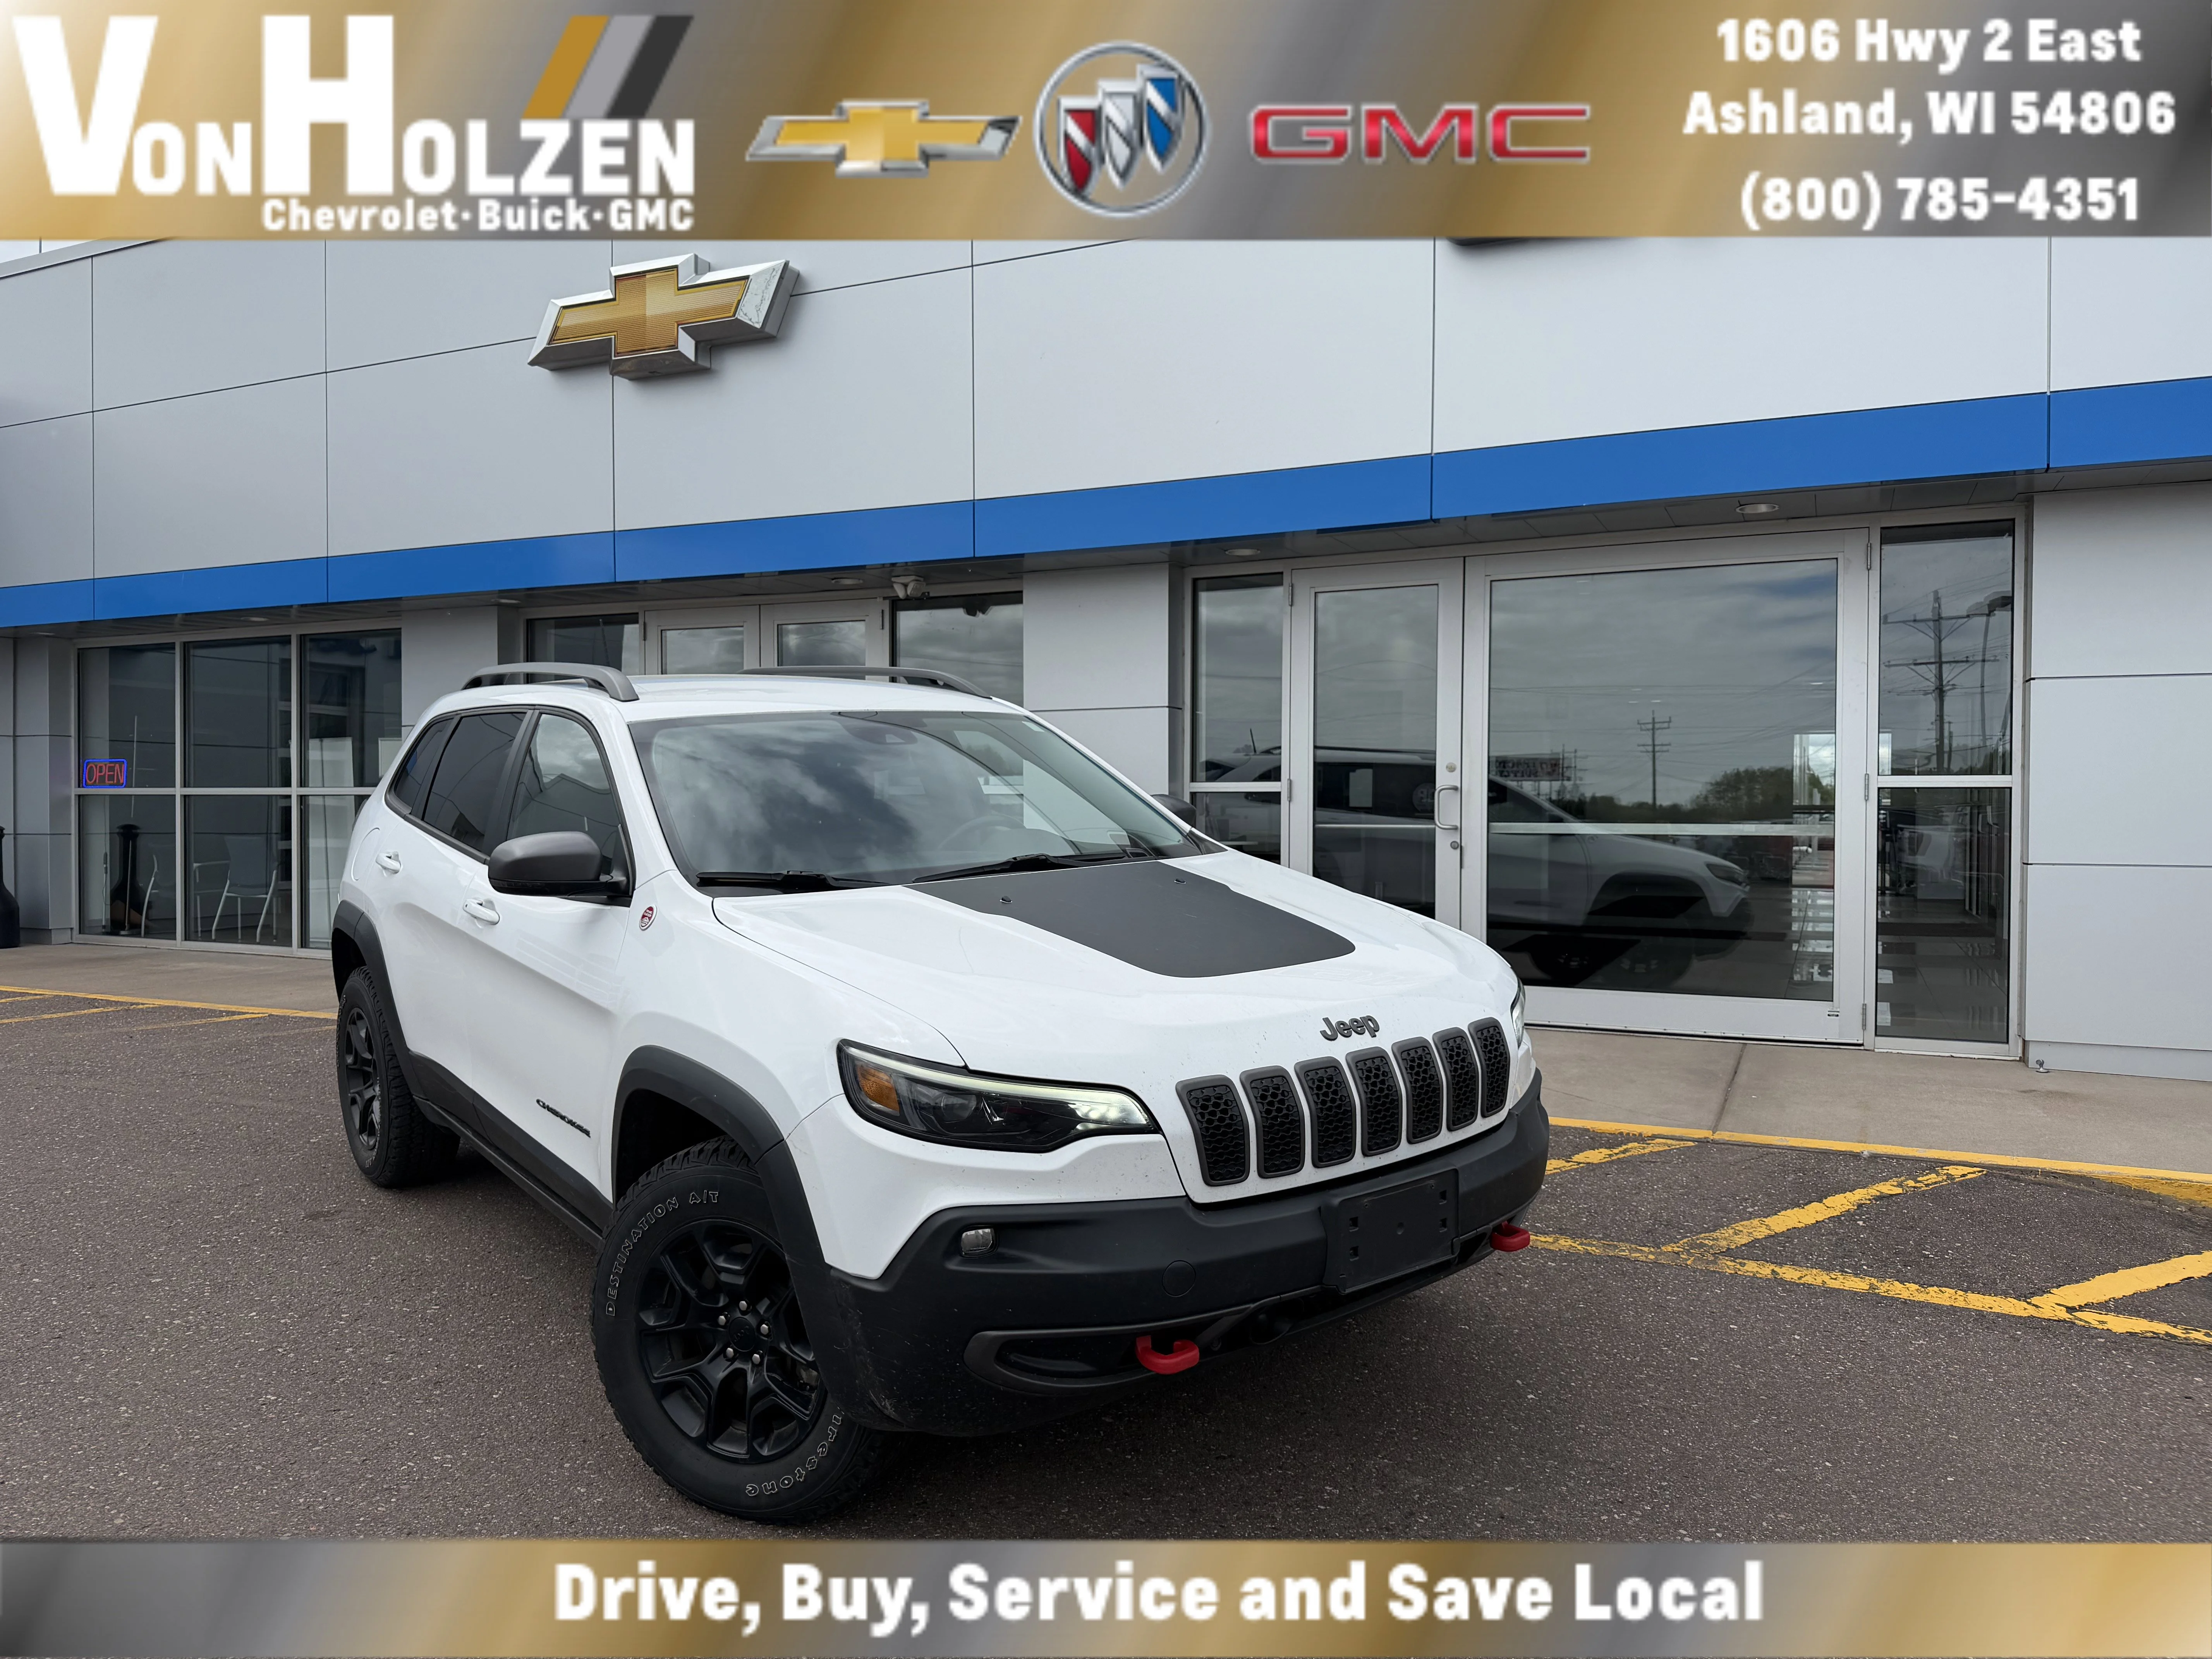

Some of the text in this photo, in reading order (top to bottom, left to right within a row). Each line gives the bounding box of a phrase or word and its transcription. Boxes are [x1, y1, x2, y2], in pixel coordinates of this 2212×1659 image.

[85, 763, 124, 784] OPEN
[1320, 1015, 1380, 1041] Jeep
[606, 1190, 719, 1317] DESTINATION A/T
[745, 1407, 845, 1497] irestone
